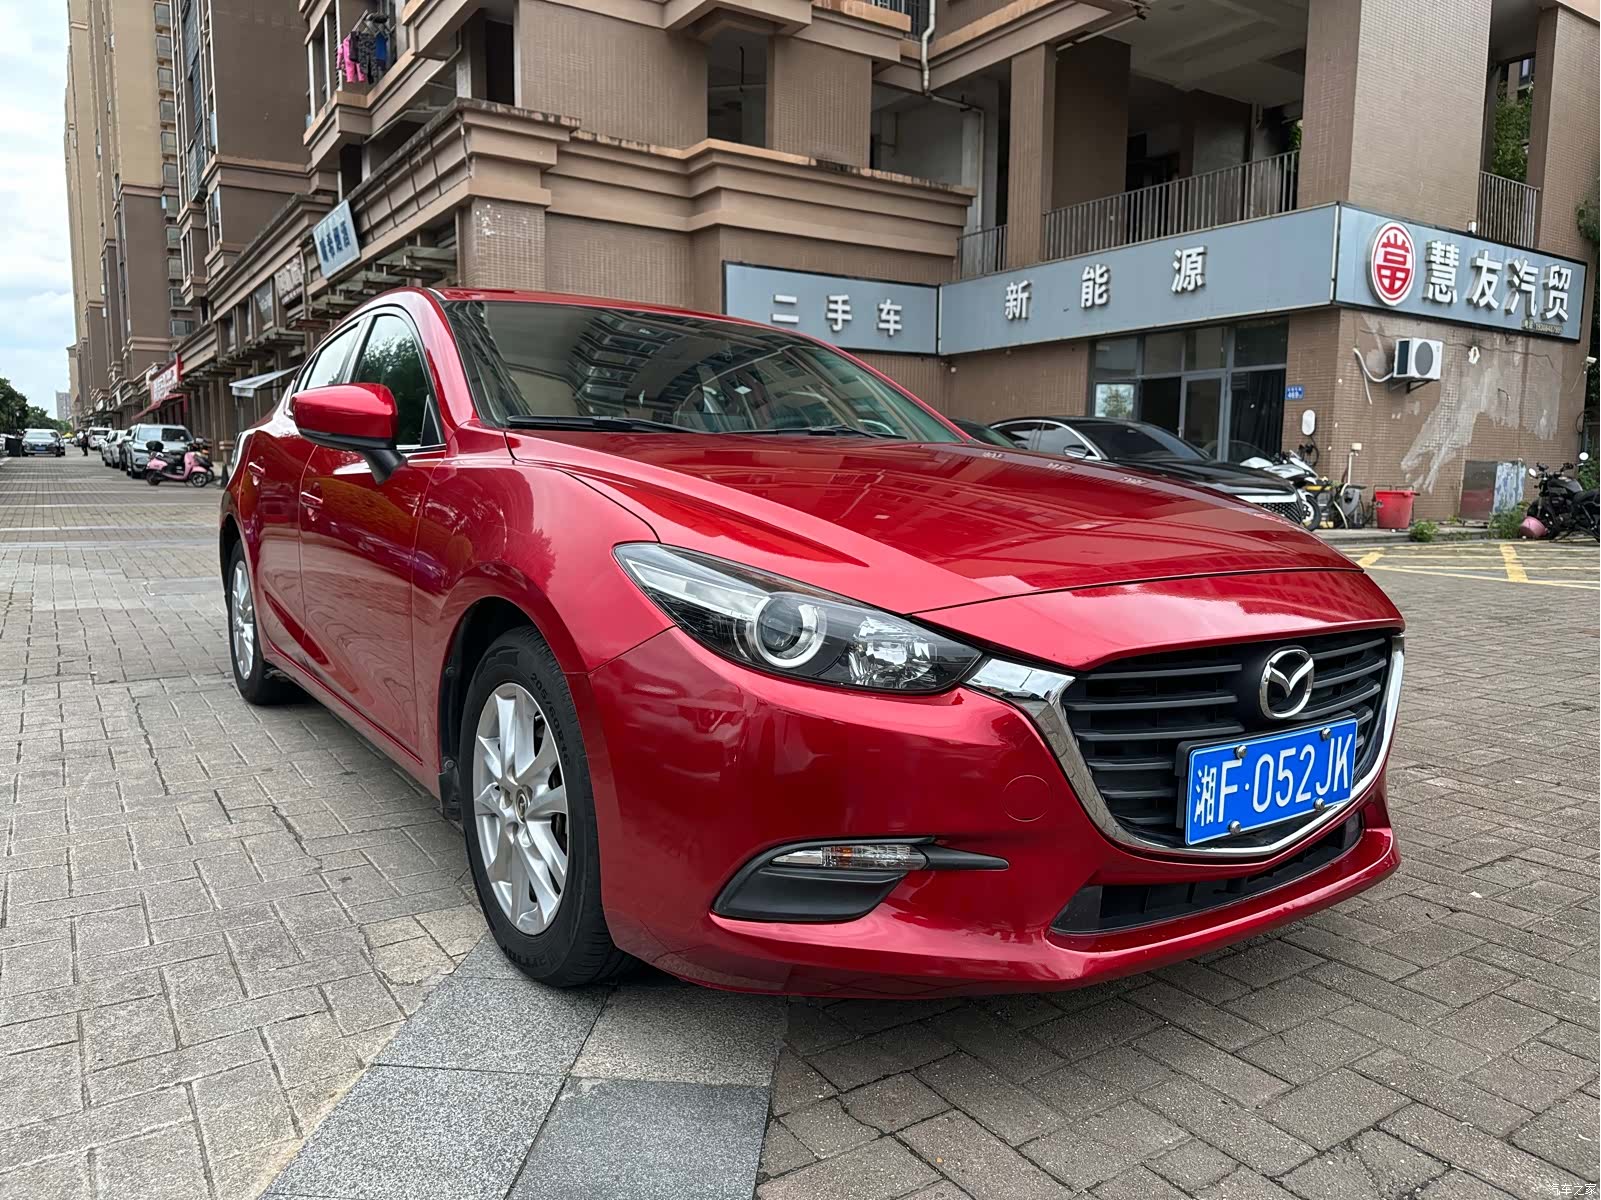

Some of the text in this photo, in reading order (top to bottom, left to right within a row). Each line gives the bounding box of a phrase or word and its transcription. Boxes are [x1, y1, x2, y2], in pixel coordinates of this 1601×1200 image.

[771, 294, 903, 337] 二手车
[1005, 245, 1207, 321] 新能源
[1426, 240, 1573, 322] 慧友汽贸
[1194, 733, 1353, 827] 湘F·052JK
